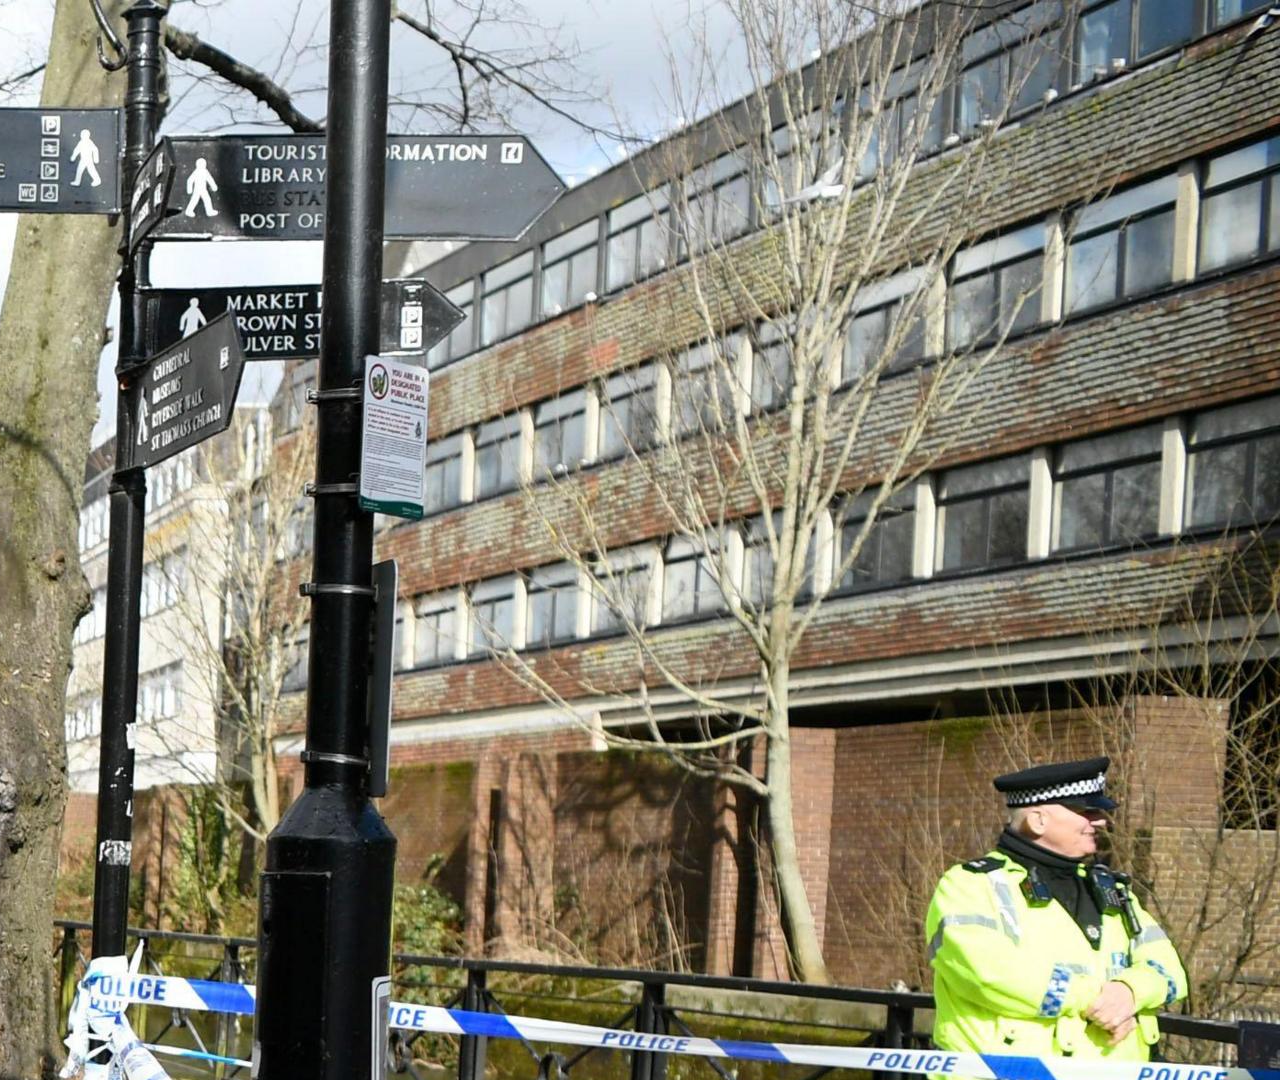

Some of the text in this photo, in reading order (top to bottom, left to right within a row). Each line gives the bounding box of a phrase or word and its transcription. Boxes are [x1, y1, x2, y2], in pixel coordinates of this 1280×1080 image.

[244, 144, 327, 161] TOURIST
[242, 167, 327, 184] LIBRARY
[20, 185, 35, 200] WC
[240, 212, 291, 229] POST
[227, 292, 309, 311] MARKET
[236, 314, 297, 332] ROWN
[153, 347, 192, 382] CATHEDRAL
[392, 369, 402, 378] YOU
[403, 371, 414, 380] ARE
[184, 387, 204, 410] WALK
[391, 389, 425, 403] PUBLIC PLACE
[192, 403, 221, 431] CHURCH
[100, 975, 167, 1001] OLICE
[600, 1031, 690, 1052] POLICE
[866, 1051, 958, 1074] POLICE
